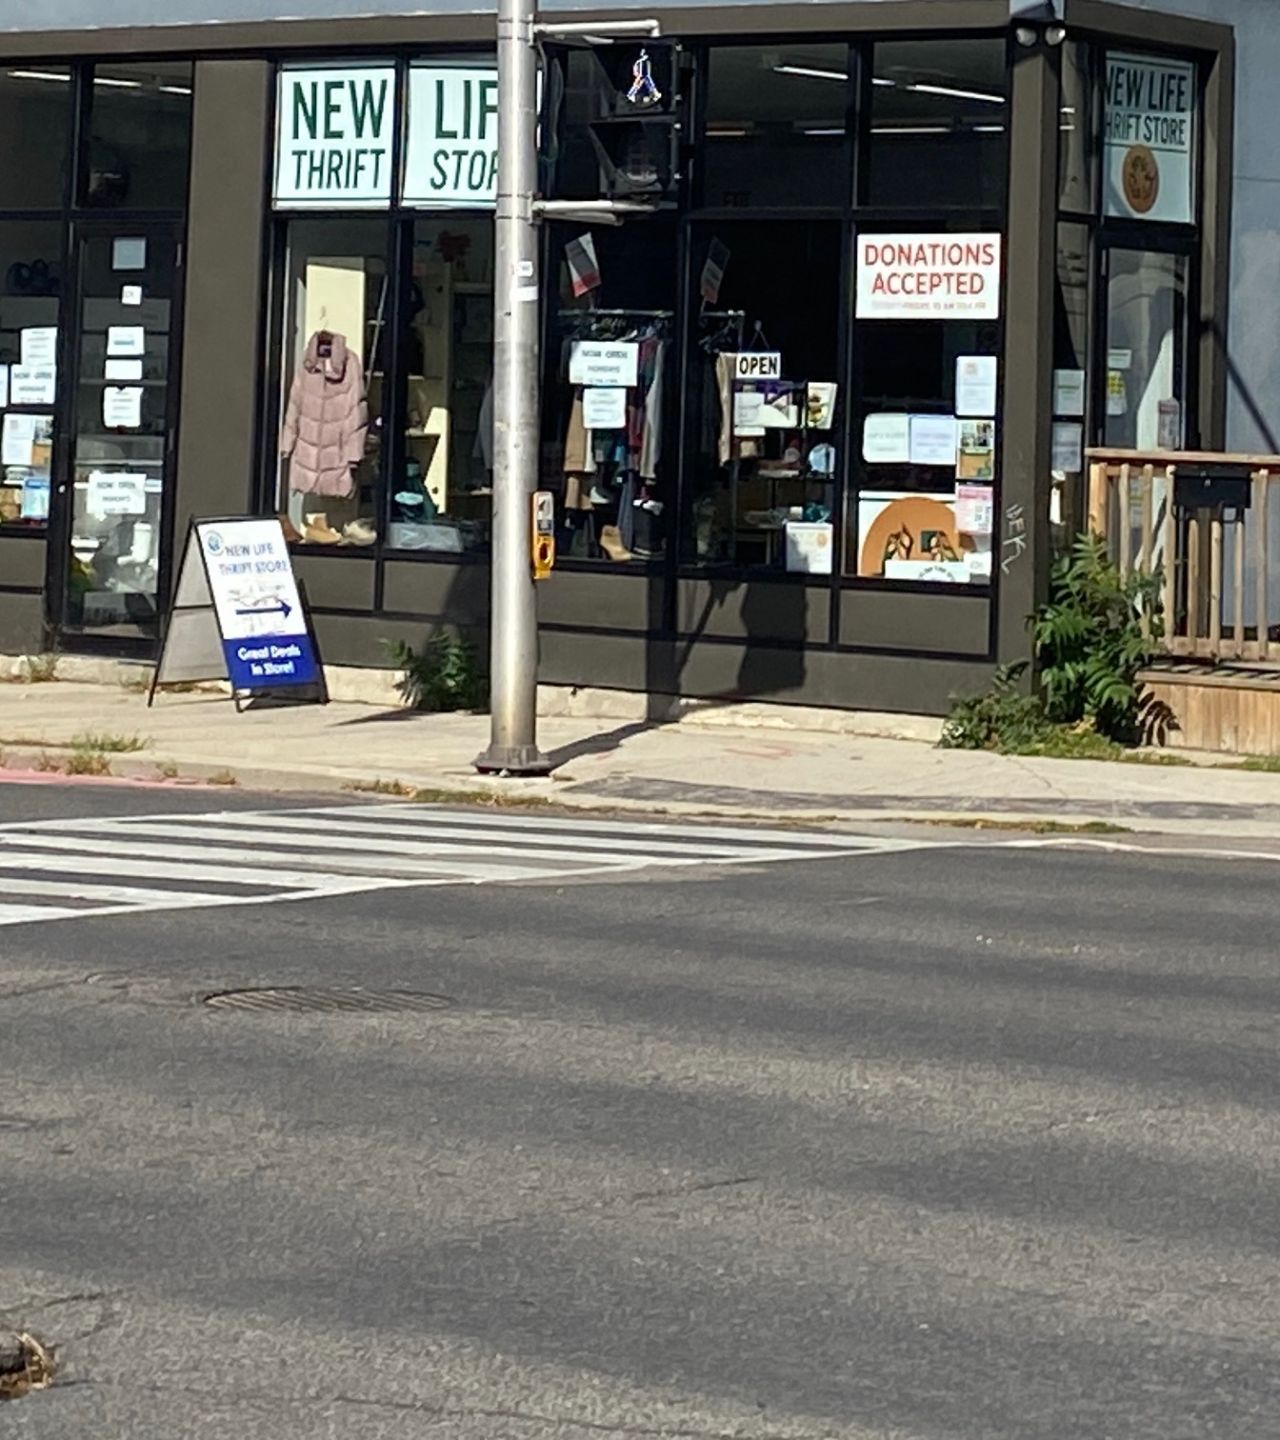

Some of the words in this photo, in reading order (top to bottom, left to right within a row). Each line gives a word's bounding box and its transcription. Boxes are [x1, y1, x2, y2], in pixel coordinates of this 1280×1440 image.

[1147, 70, 1188, 113] LIFE
[292, 79, 388, 140] NEW
[435, 79, 498, 140] LIF
[1105, 111, 1141, 142] HRIFT
[1143, 115, 1187, 146] STORE
[291, 148, 386, 190] THRIFT
[429, 148, 498, 191] STOR
[864, 243, 995, 266] DONATIONS
[871, 272, 985, 295] ACCEPTED
[739, 356, 778, 375] OPEN
